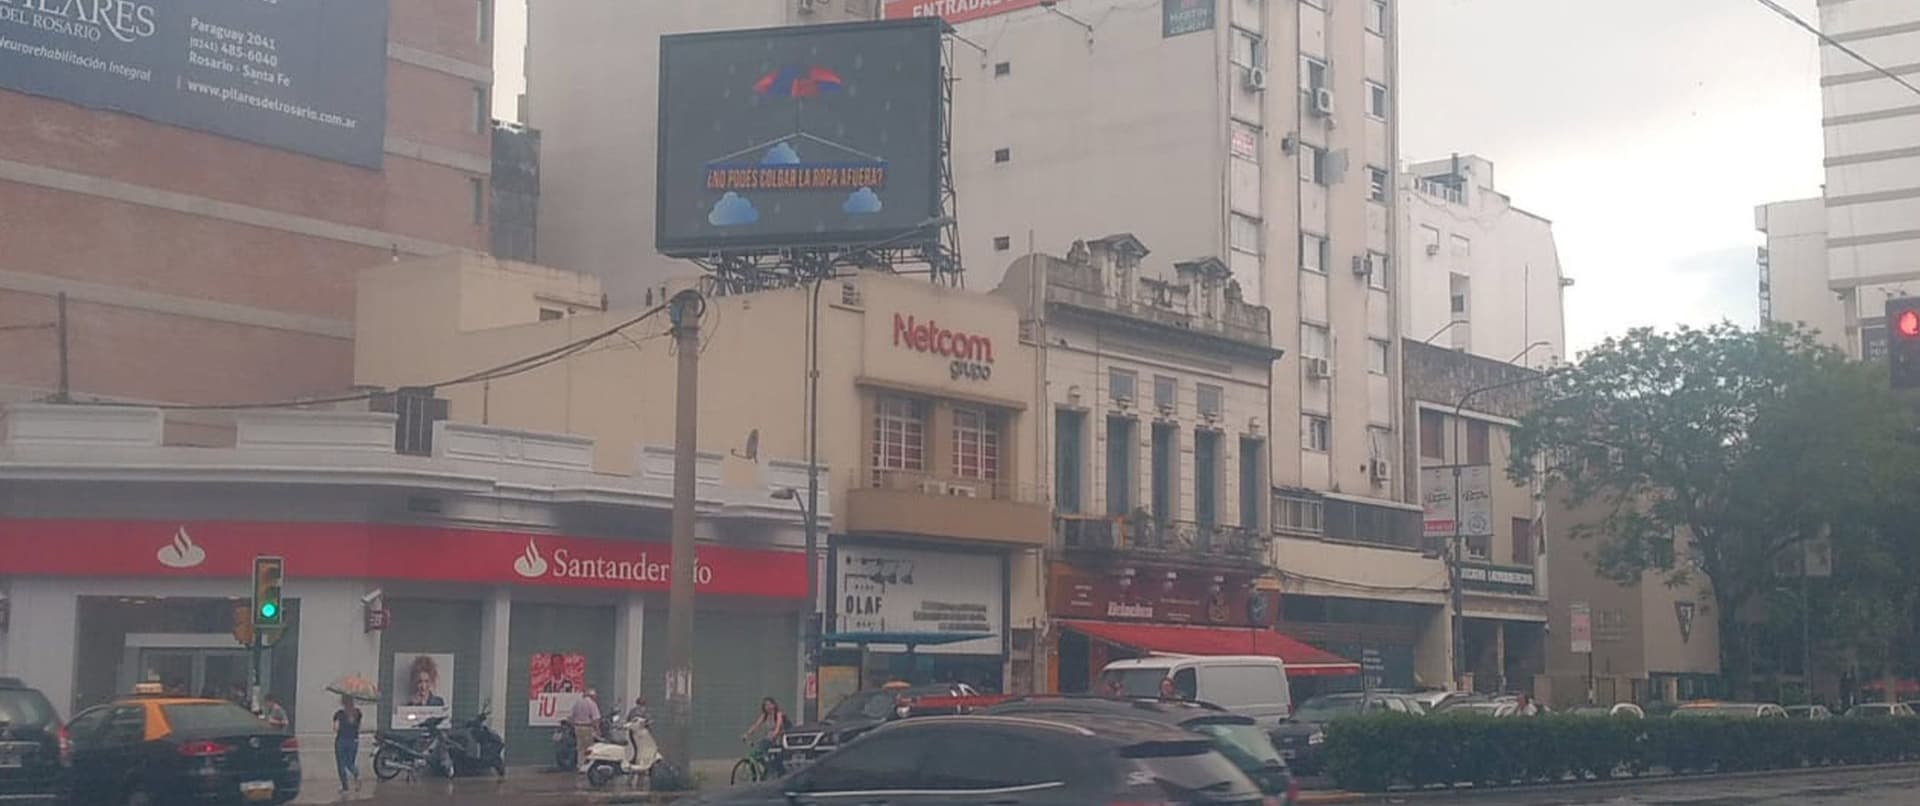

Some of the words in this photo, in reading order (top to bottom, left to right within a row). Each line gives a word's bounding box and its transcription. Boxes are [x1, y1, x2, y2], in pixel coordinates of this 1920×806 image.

[0, 5, 29, 24] DEL
[33, 14, 101, 41] ROSARIO
[190, 16, 244, 44] Paraguay
[247, 31, 276, 50] 2041
[189, 51, 233, 73] Rosario
[242, 64, 275, 83] Santa
[277, 73, 291, 87] Fe
[221, 44, 278, 67] 485-6040
[109, 61, 152, 82] Integral
[187, 80, 357, 129] www.pilaresdelrosario.com.ar
[727, 167, 758, 187] PODES
[760, 167, 796, 187] COLGAR
[799, 167, 811, 186] LA
[812, 167, 839, 187] ROPA
[840, 166, 883, 187] AFUERA?
[949, 359, 992, 381] grupo
[553, 548, 669, 583] Santander
[845, 595, 883, 615] OLAF
